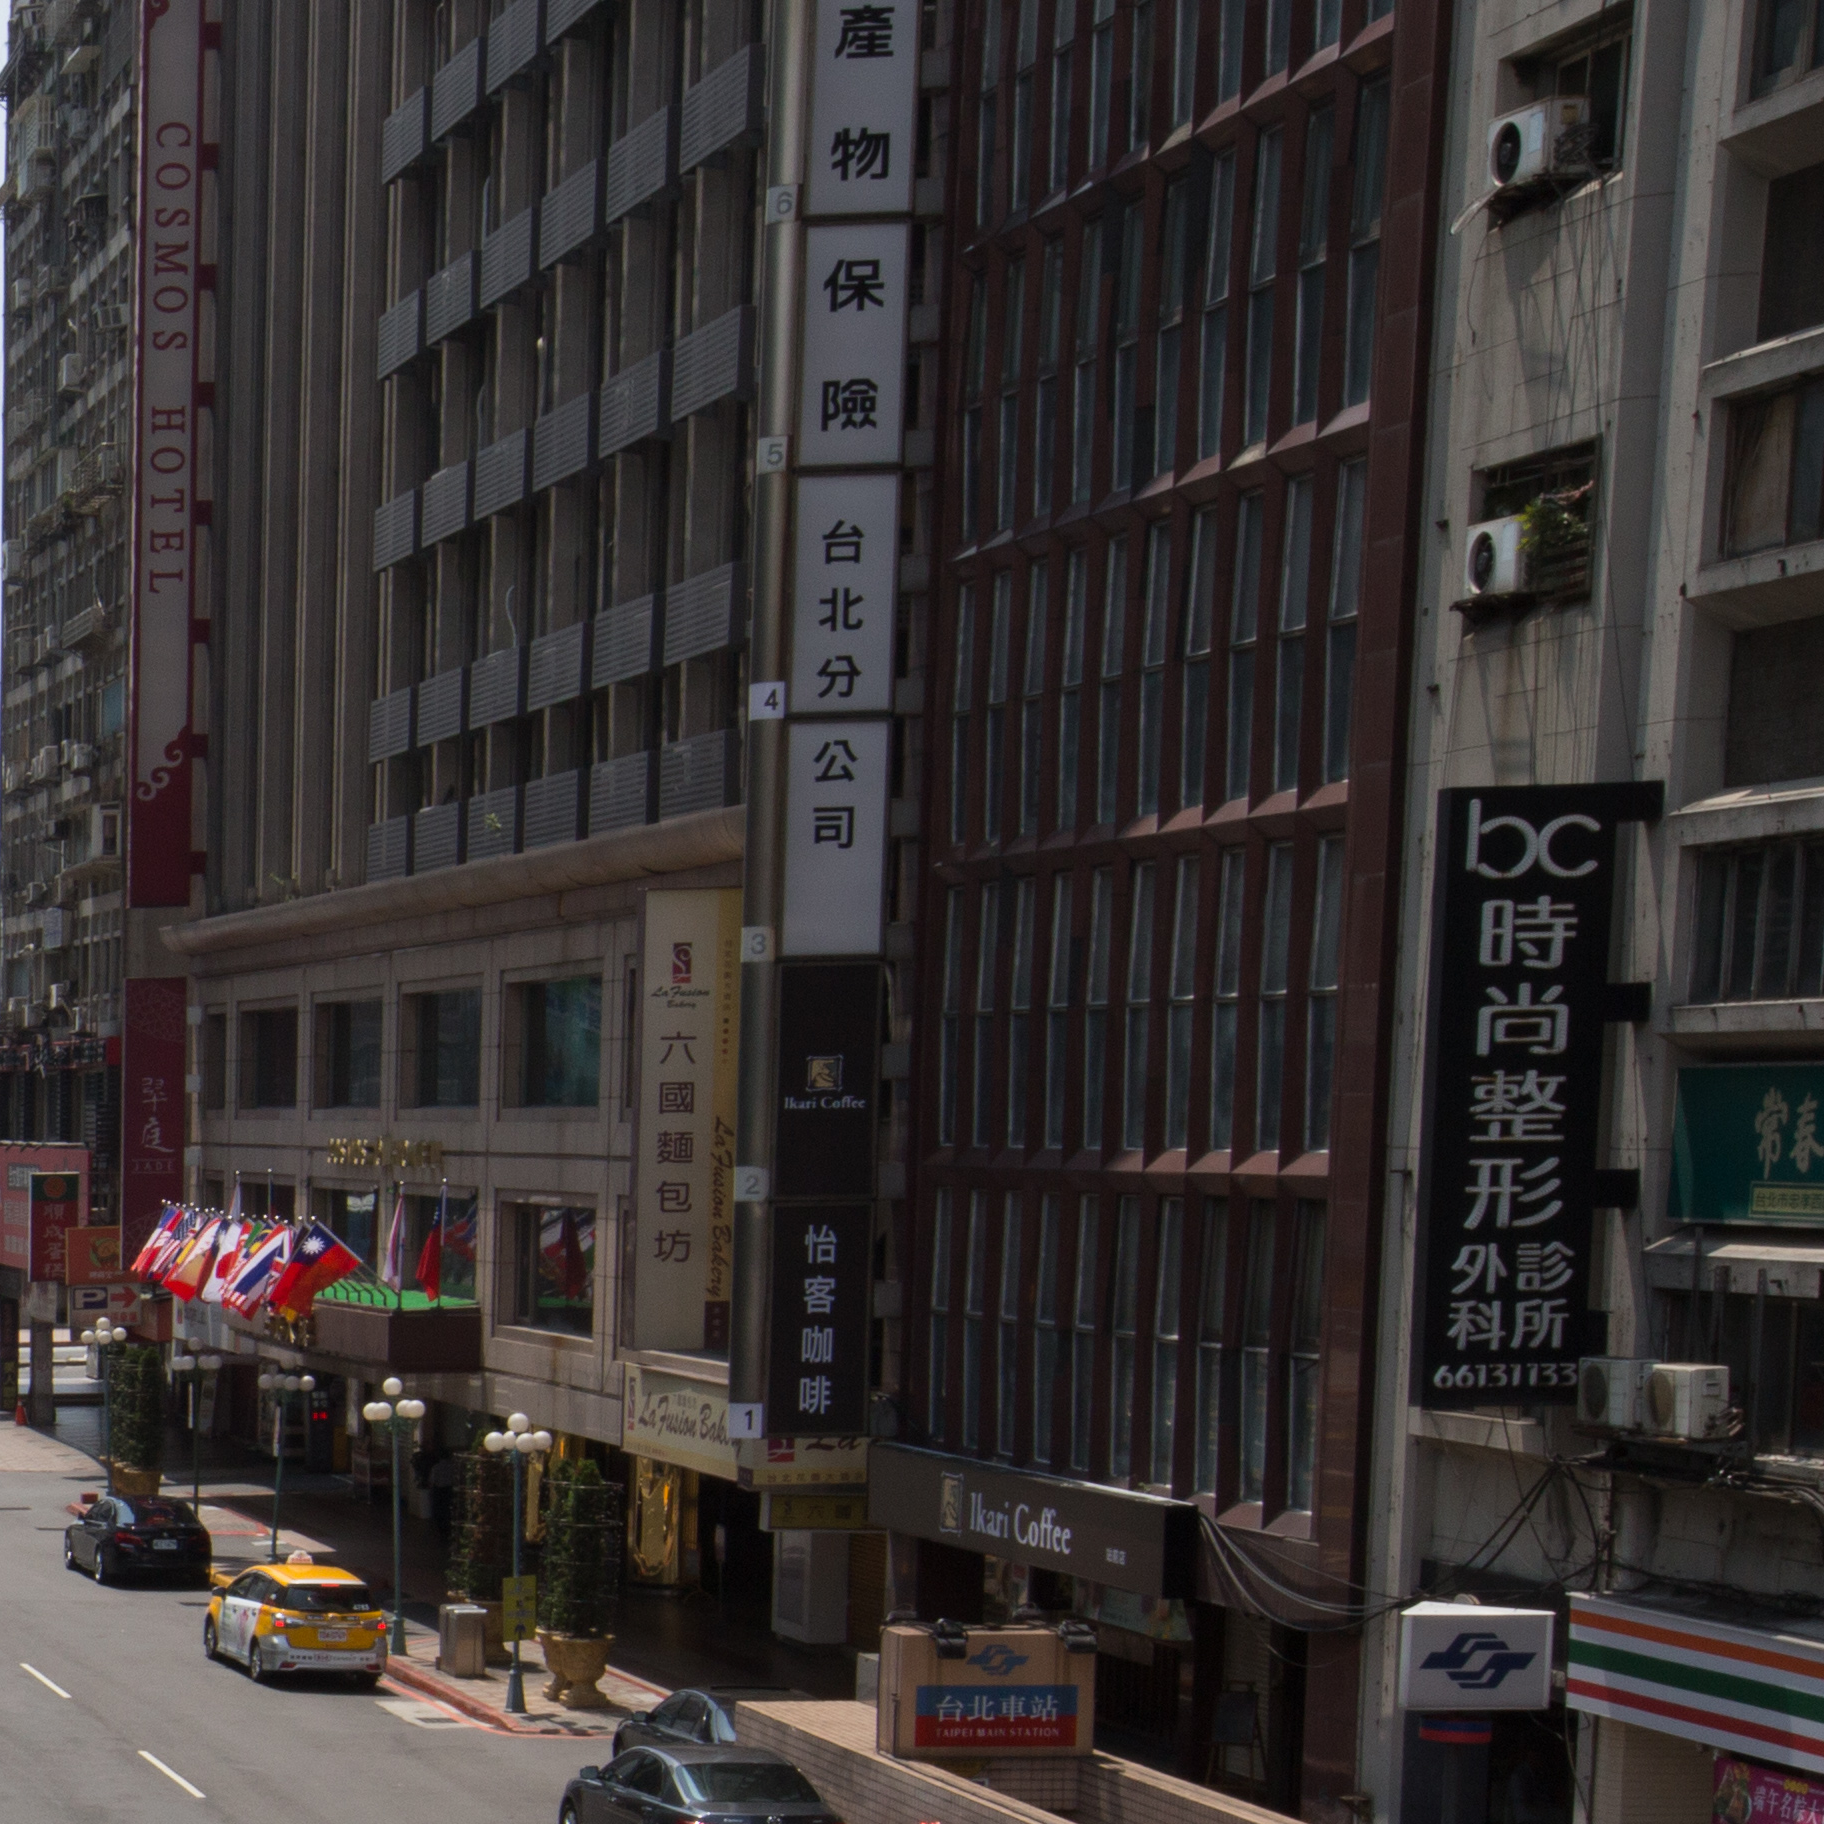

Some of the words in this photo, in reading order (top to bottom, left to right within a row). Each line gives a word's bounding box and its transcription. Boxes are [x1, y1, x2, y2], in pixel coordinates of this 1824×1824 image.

[775, 192, 793, 215] 6
[151, 121, 193, 352] COSMOS
[765, 443, 783, 467] 5
[148, 405, 187, 595] HOTEL
[812, 518, 865, 850] 台北分公司
[762, 688, 779, 712] 4
[749, 932, 767, 956] 3
[1463, 894, 1579, 1231] 時尚整形
[784, 1096, 816, 1110] Ikari
[819, 1095, 866, 1111] Coffee
[653, 1031, 698, 1264] 六國麵包坊
[743, 1174, 760, 1196] 2
[796, 1223, 838, 1416] 怡客咖啡
[1432, 1362, 1579, 1389] 66131133
[744, 1408, 754, 1432] 1
[970, 1492, 1010, 1539] Ikari
[1014, 1503, 1072, 1554] Coffee
[936, 1694, 1060, 1723] 台北車站
[936, 1728, 973, 1738] TAIPEI
[976, 1728, 1004, 1737] MAIN
[1009, 1727, 1060, 1737] STATION
